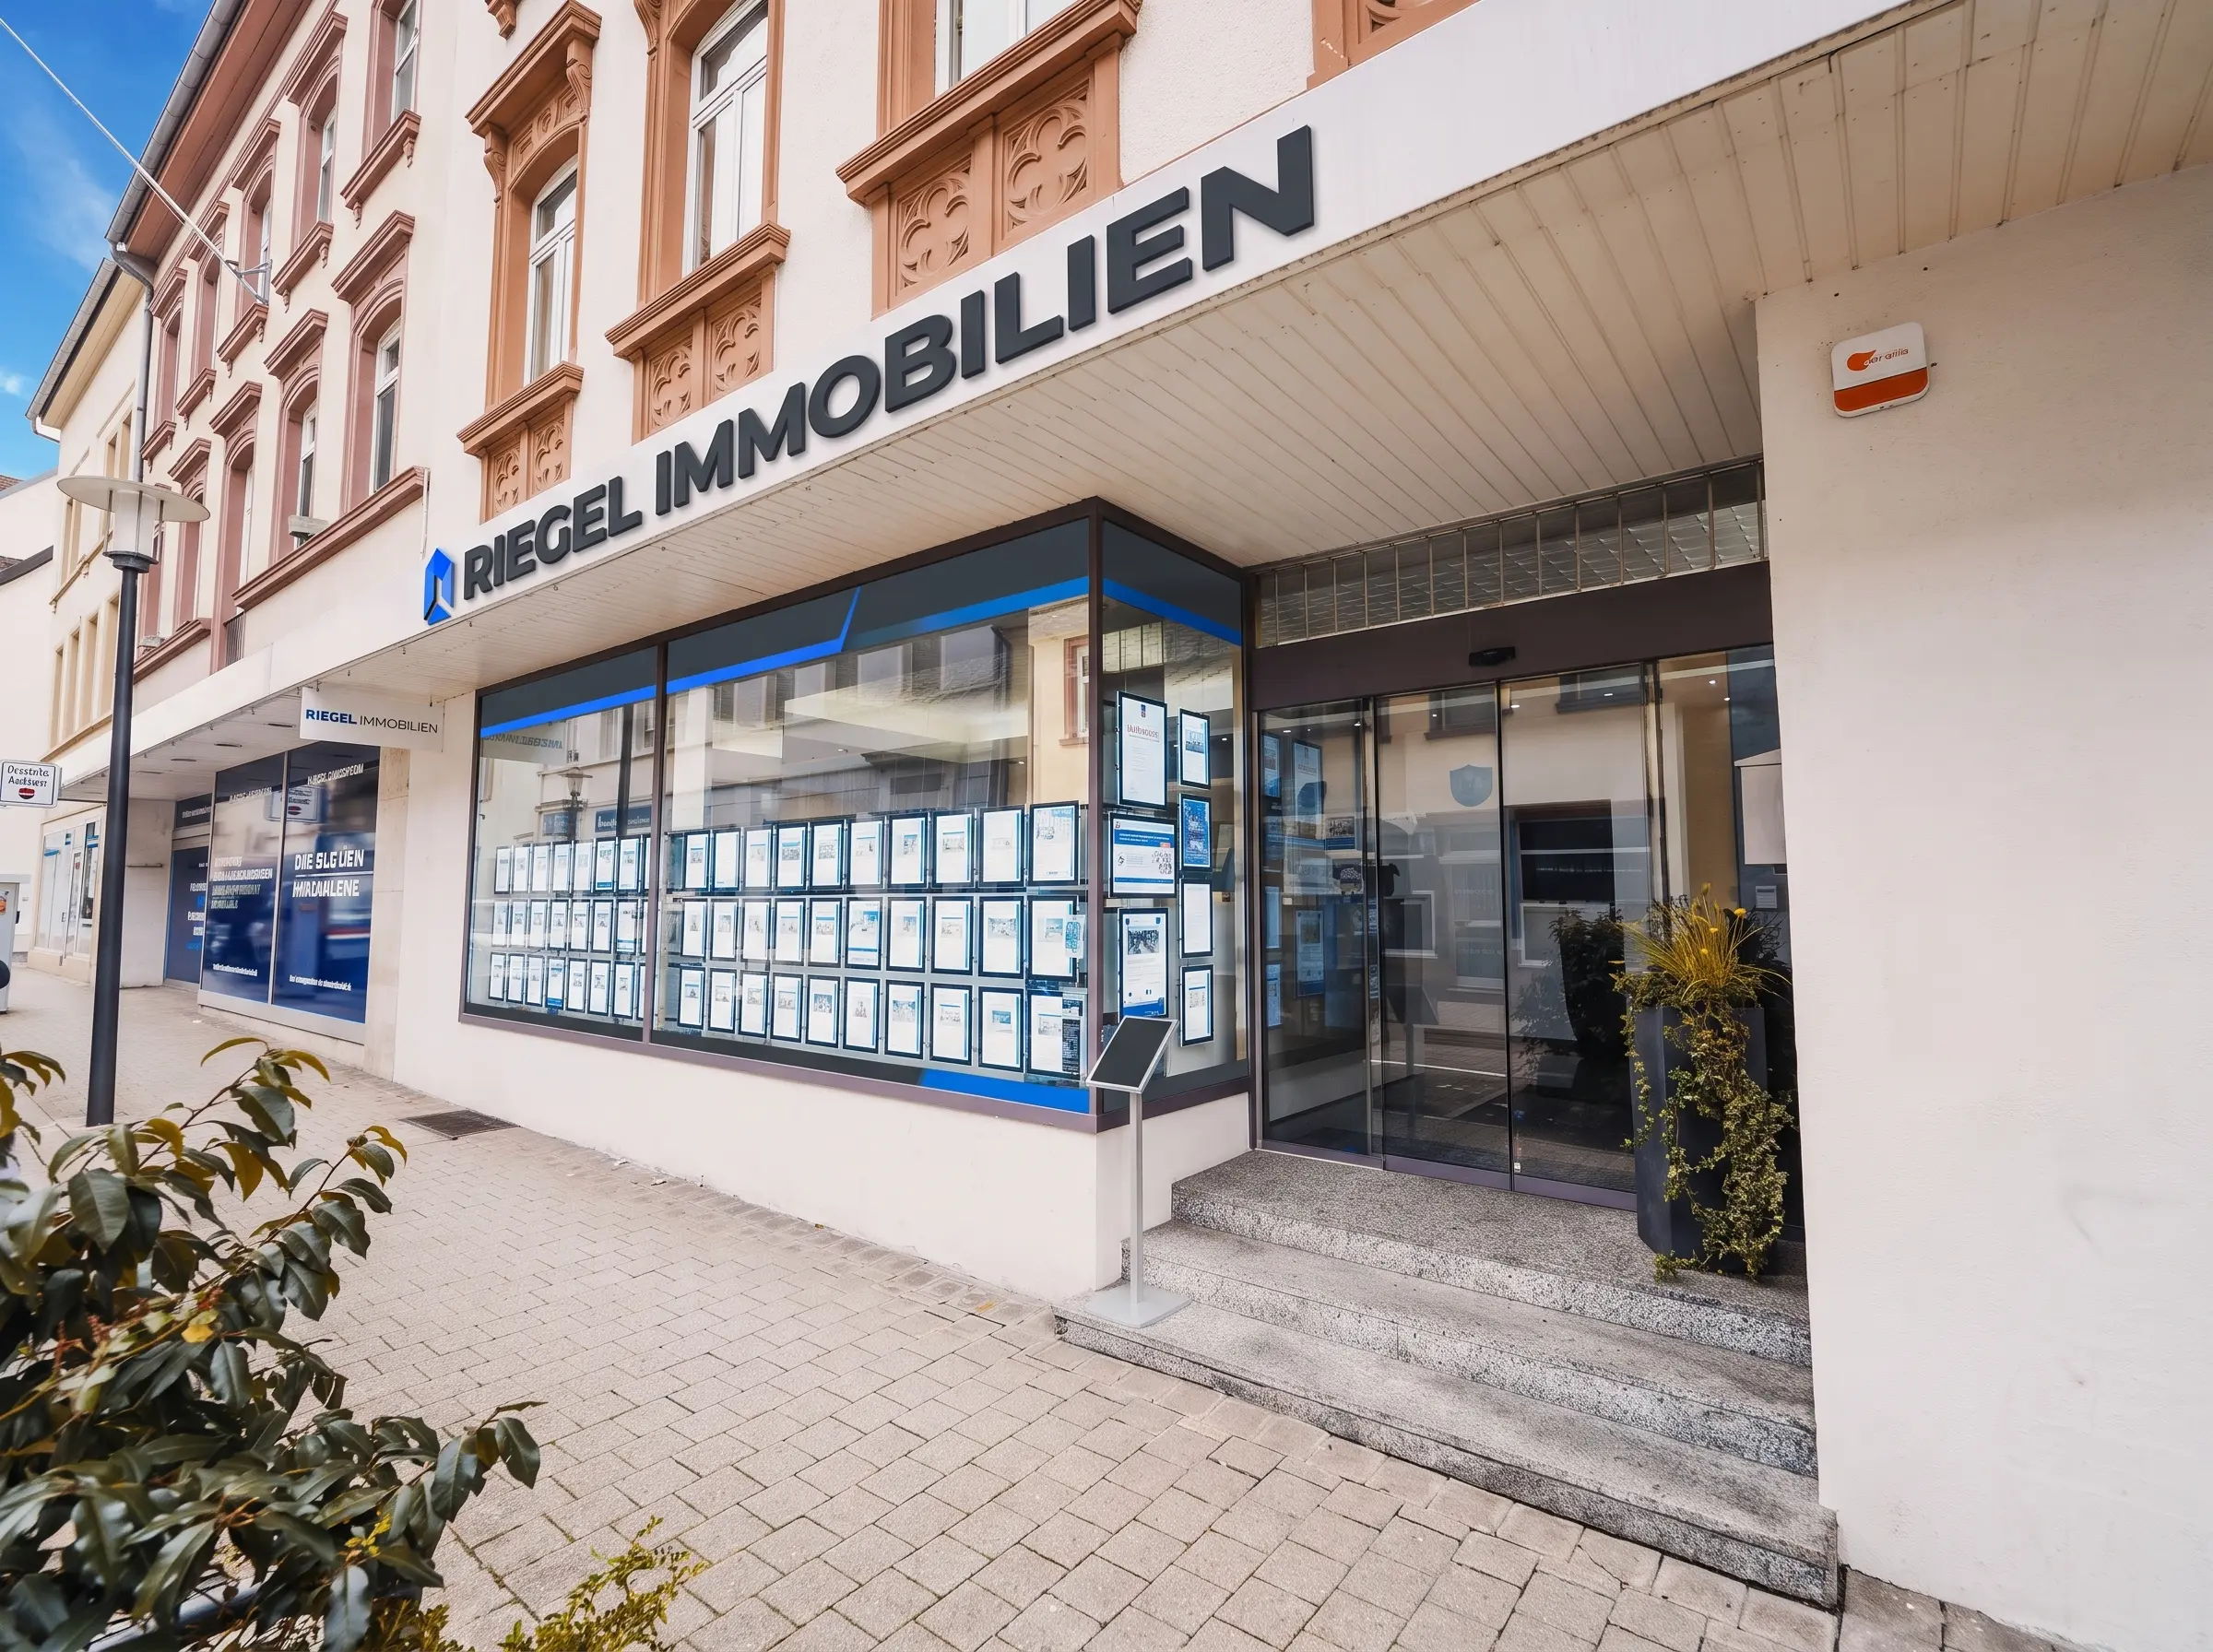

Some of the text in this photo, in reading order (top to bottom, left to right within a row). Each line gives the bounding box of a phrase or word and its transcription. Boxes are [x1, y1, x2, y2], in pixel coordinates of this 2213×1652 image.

[463, 125, 1316, 600] RIEGEL IMMOBILIEN
[305, 709, 439, 734] RIEGEL IMMOBILIEN
